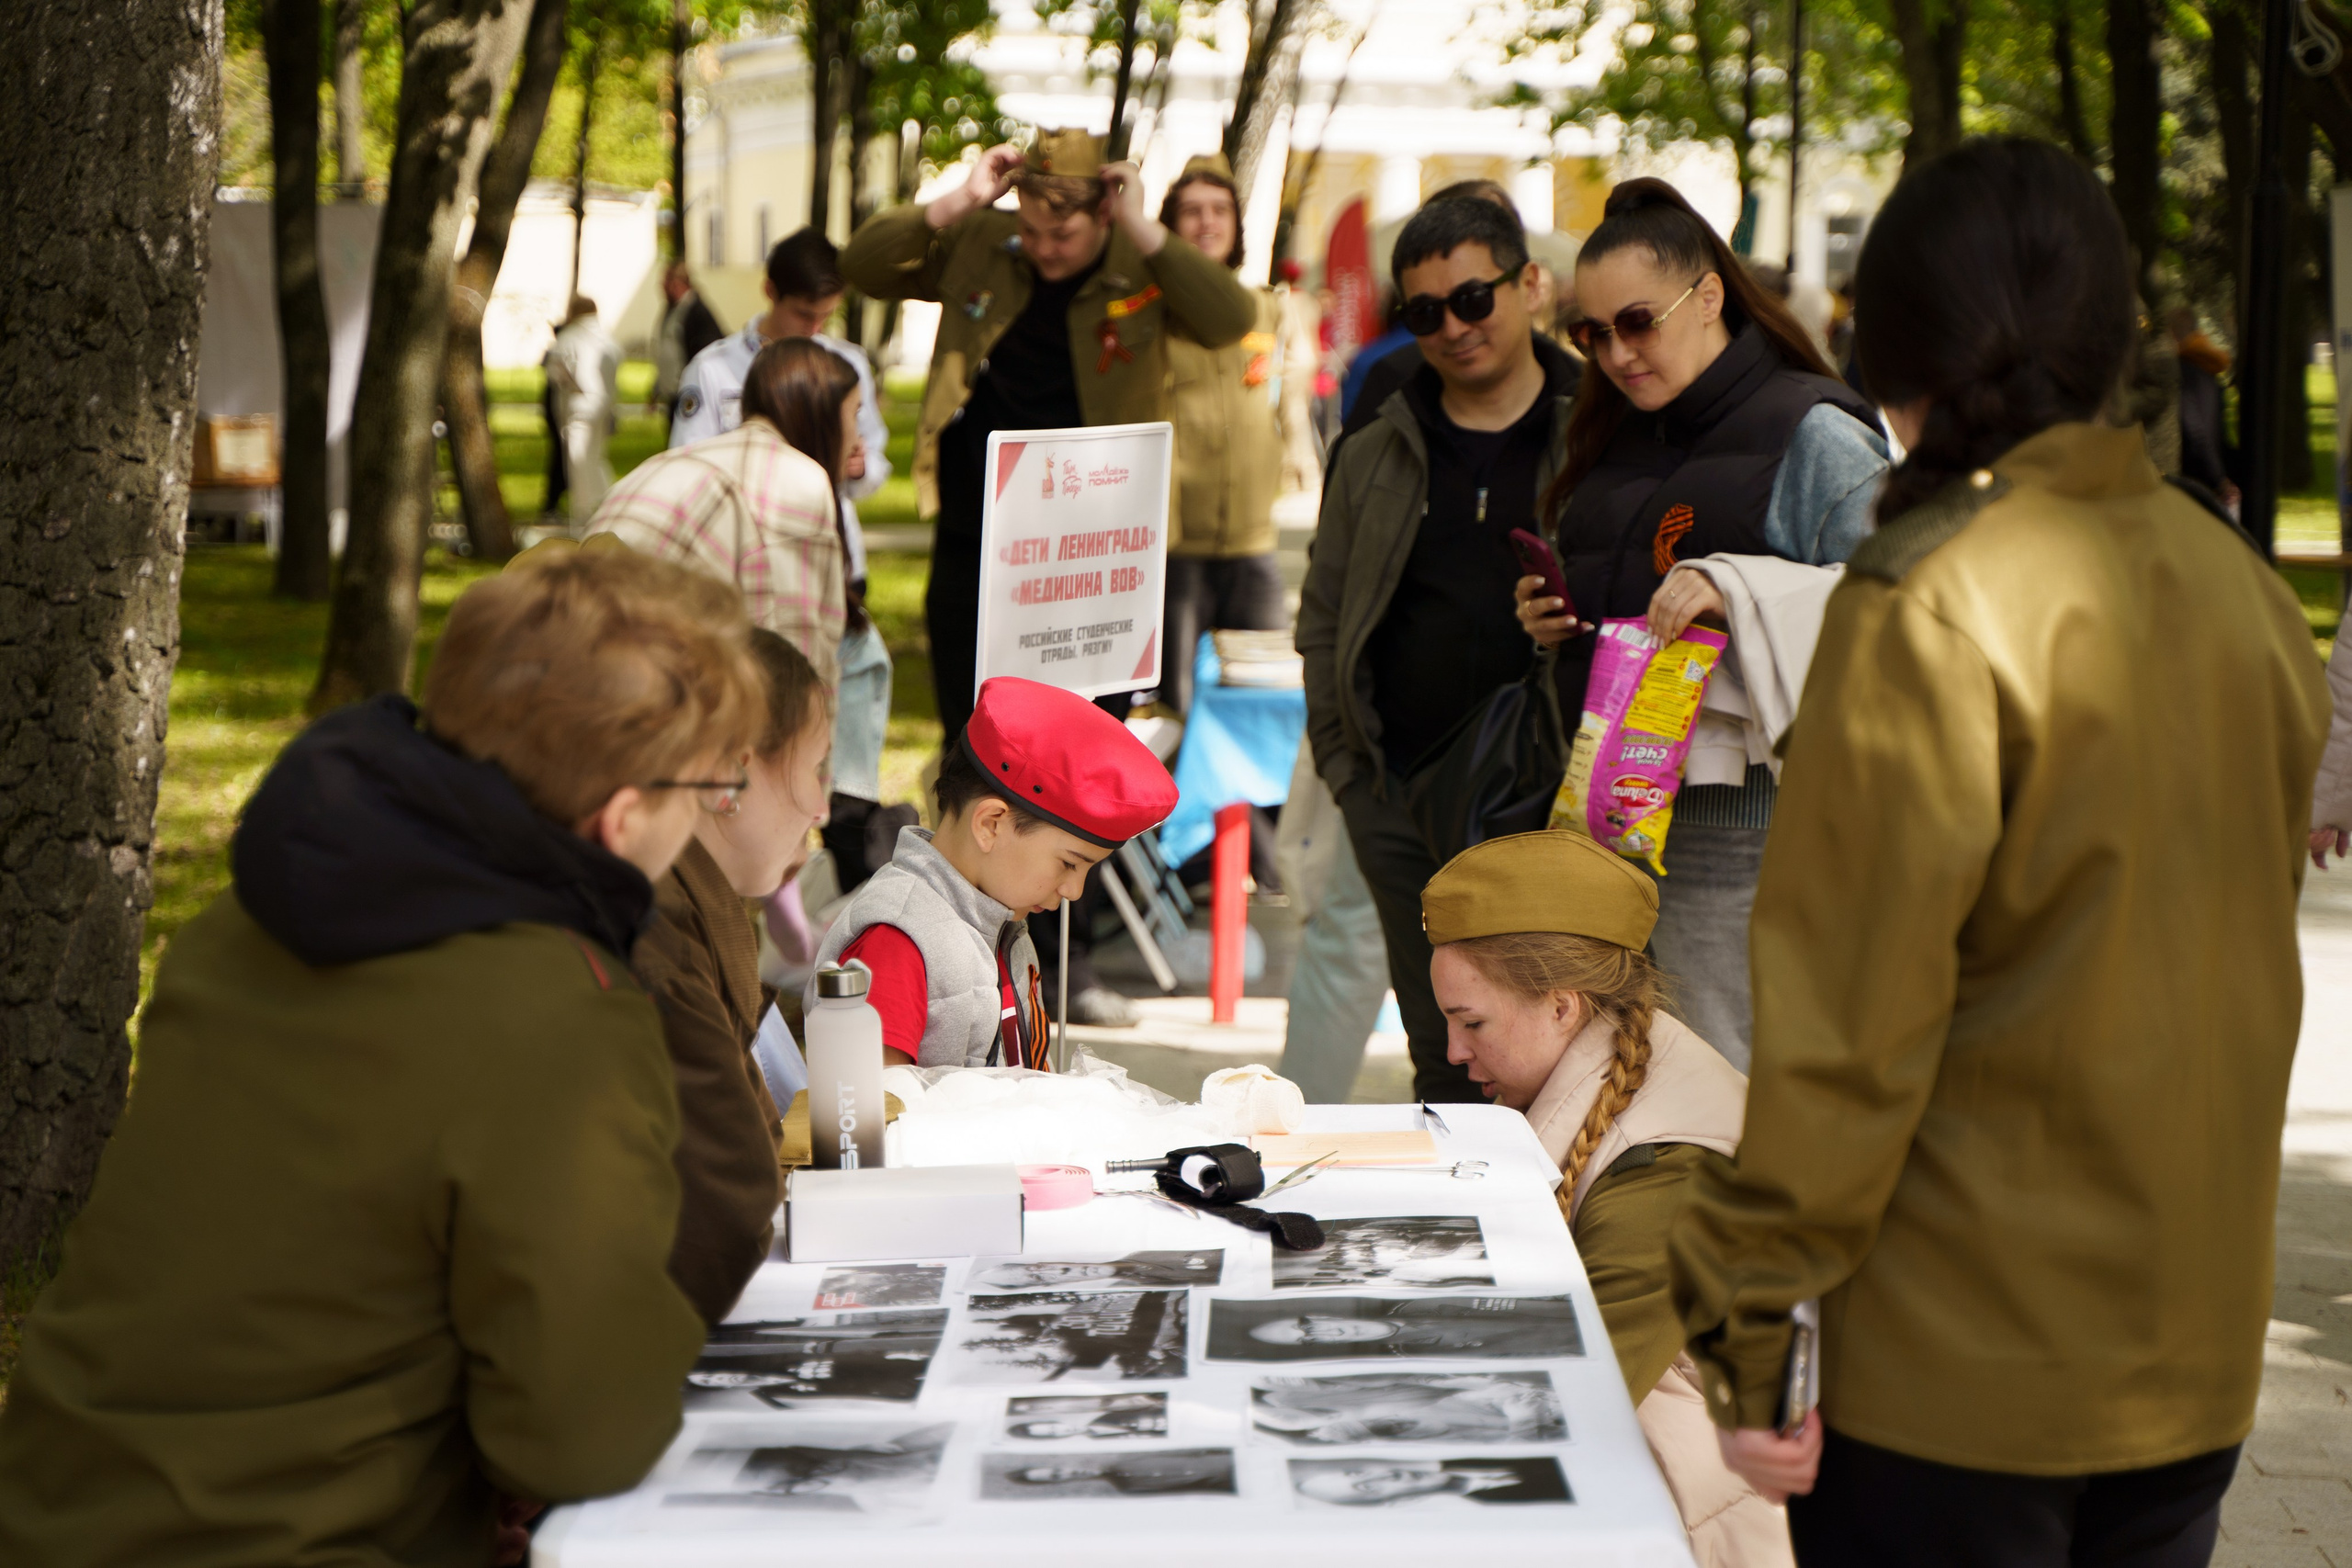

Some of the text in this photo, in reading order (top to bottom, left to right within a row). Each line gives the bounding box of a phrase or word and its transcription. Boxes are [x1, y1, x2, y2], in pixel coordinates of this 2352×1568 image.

[1089, 476, 1129, 487] ПОМНИТ
[1000, 525, 1156, 566] «ДЕТИ ЛЕНИНГРАДА»
[1011, 566, 1145, 606] «МЕДИЦИНА ВОВ»
[1019, 618, 1134, 649] РОССИЙСКИЕ СТУДЕНЧЕСКИЕ
[837, 1081, 858, 1169] SPORT
